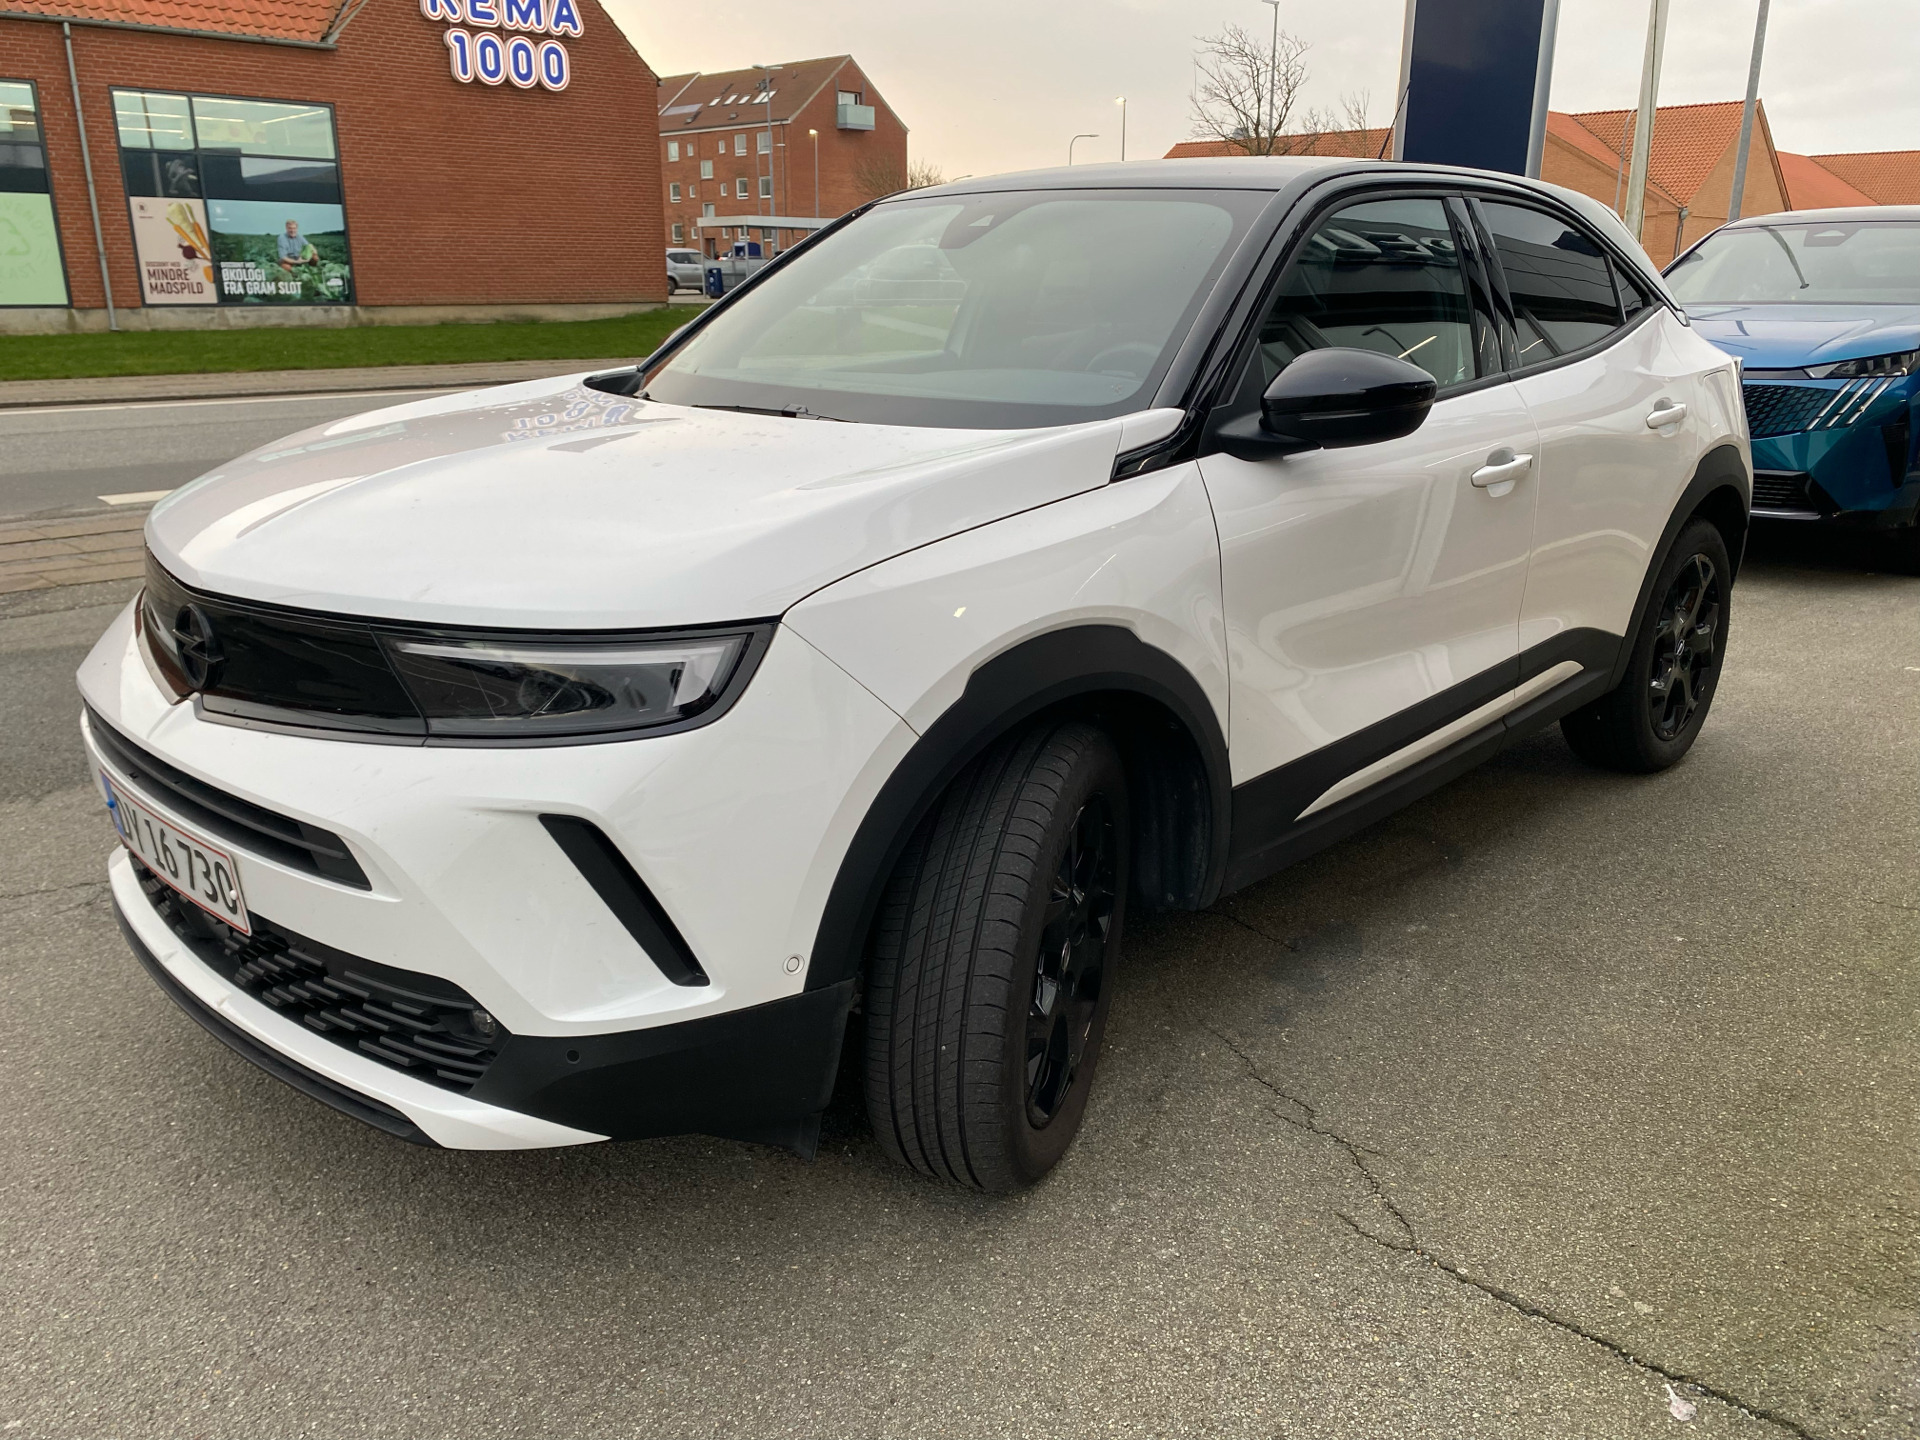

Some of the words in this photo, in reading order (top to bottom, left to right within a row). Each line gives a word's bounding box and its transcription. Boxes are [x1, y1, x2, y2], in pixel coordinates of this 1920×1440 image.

[443, 28, 571, 92] 1000
[147, 268, 191, 282] MINDRE
[221, 268, 267, 282] ØKOLOGI
[149, 281, 204, 295] MADSPILD
[223, 281, 245, 295] FRA
[246, 281, 277, 295] GRAM
[278, 281, 303, 295] SLOT
[112, 790, 145, 854] DY
[143, 818, 179, 879] 16
[176, 838, 238, 915] 730
